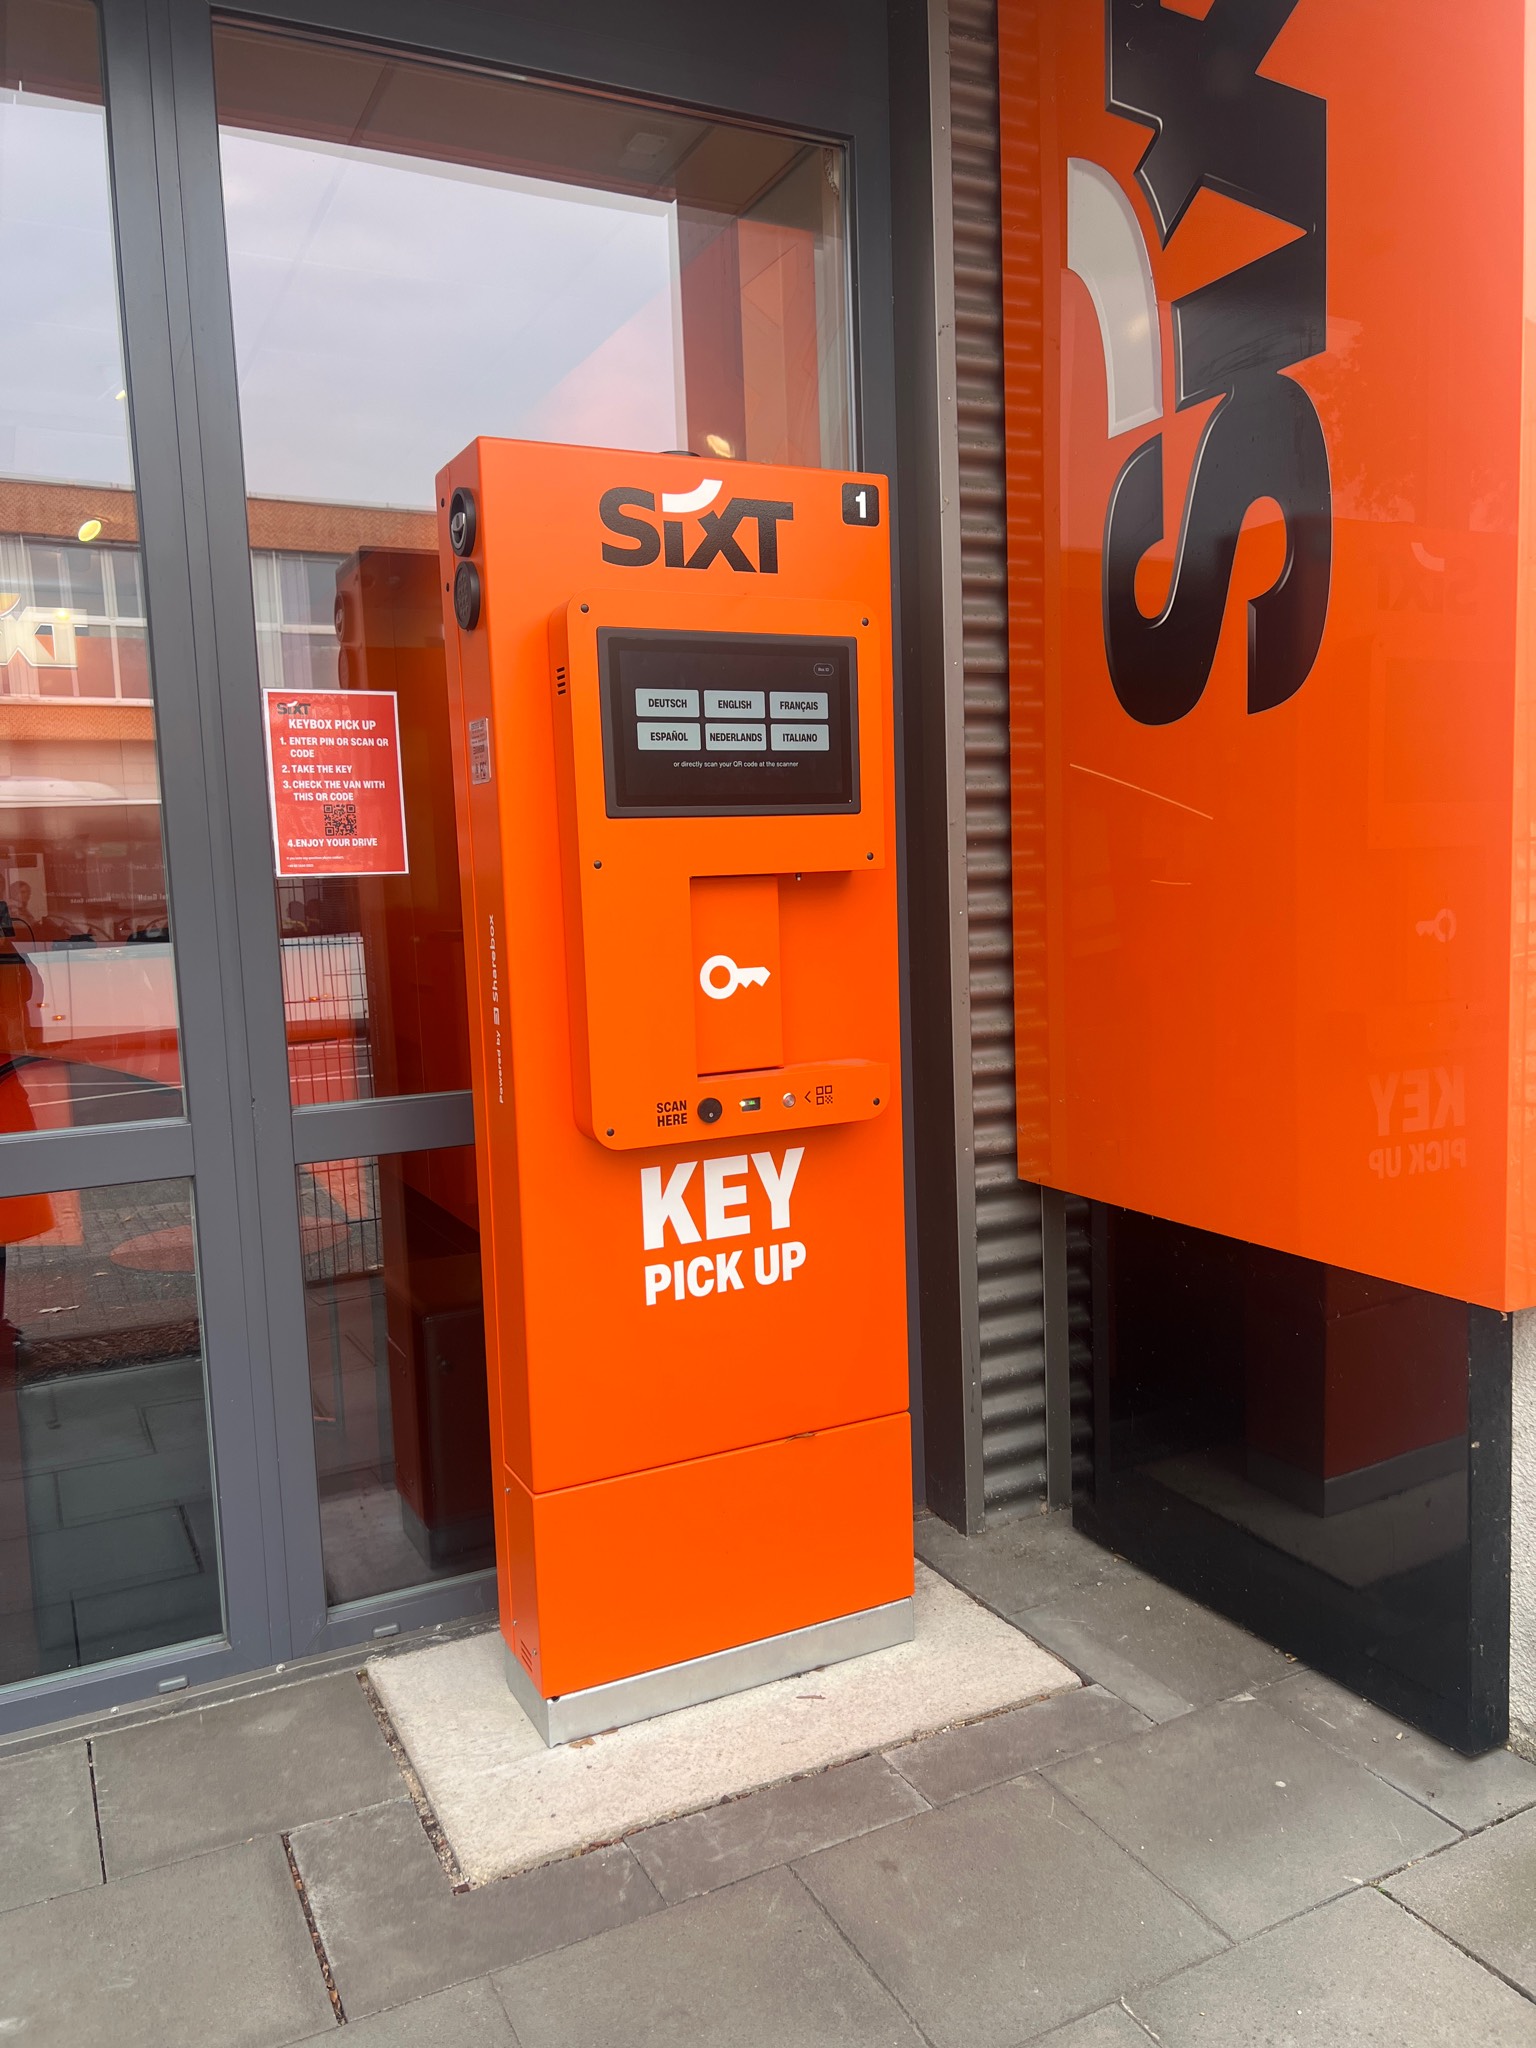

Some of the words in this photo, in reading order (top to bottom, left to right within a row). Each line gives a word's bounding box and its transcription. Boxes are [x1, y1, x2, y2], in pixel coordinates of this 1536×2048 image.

[855, 491, 867, 518] 1
[648, 698, 688, 709] DEUTSCH
[717, 700, 752, 710] ENGLISH
[779, 701, 819, 713] FRANÇAIS
[288, 718, 332, 730] KEYBOX
[334, 719, 360, 730] PICK
[361, 720, 376, 731] UP
[650, 730, 689, 742] ESPAÑOL
[709, 732, 763, 742] NEDERLANDS
[782, 733, 818, 743] ITALIANO
[279, 736, 287, 746] 1.
[289, 736, 318, 746] ENTER
[319, 737, 335, 747] PIN
[336, 737, 349, 747] OR
[350, 737, 375, 747] SCAN
[376, 738, 389, 748] QR
[290, 749, 315, 758] CODE
[281, 764, 290, 774] 2.
[291, 764, 315, 774] TAKE
[316, 764, 334, 774] THE
[335, 764, 353, 774] KEY
[680, 760, 703, 769] directly
[719, 761, 732, 770] your
[732, 760, 743, 768] QR
[743, 760, 758, 768] code
[765, 760, 776, 768] the
[282, 780, 292, 789] 3.
[292, 779, 322, 789] CHECK
[324, 780, 342, 789] THE
[343, 780, 361, 789] VAN
[363, 780, 386, 789] WITH
[293, 792, 314, 801] THIS
[315, 792, 329, 802] QR
[329, 792, 354, 801] CODE
[326, 838, 351, 847] YOUR
[352, 838, 378, 847] DRIVE
[656, 1100, 687, 1113] SCAN
[657, 1112, 688, 1127] HERE
[640, 1146, 806, 1251] KEY
[644, 1250, 745, 1306] PICK
[754, 1241, 807, 1286] UP
